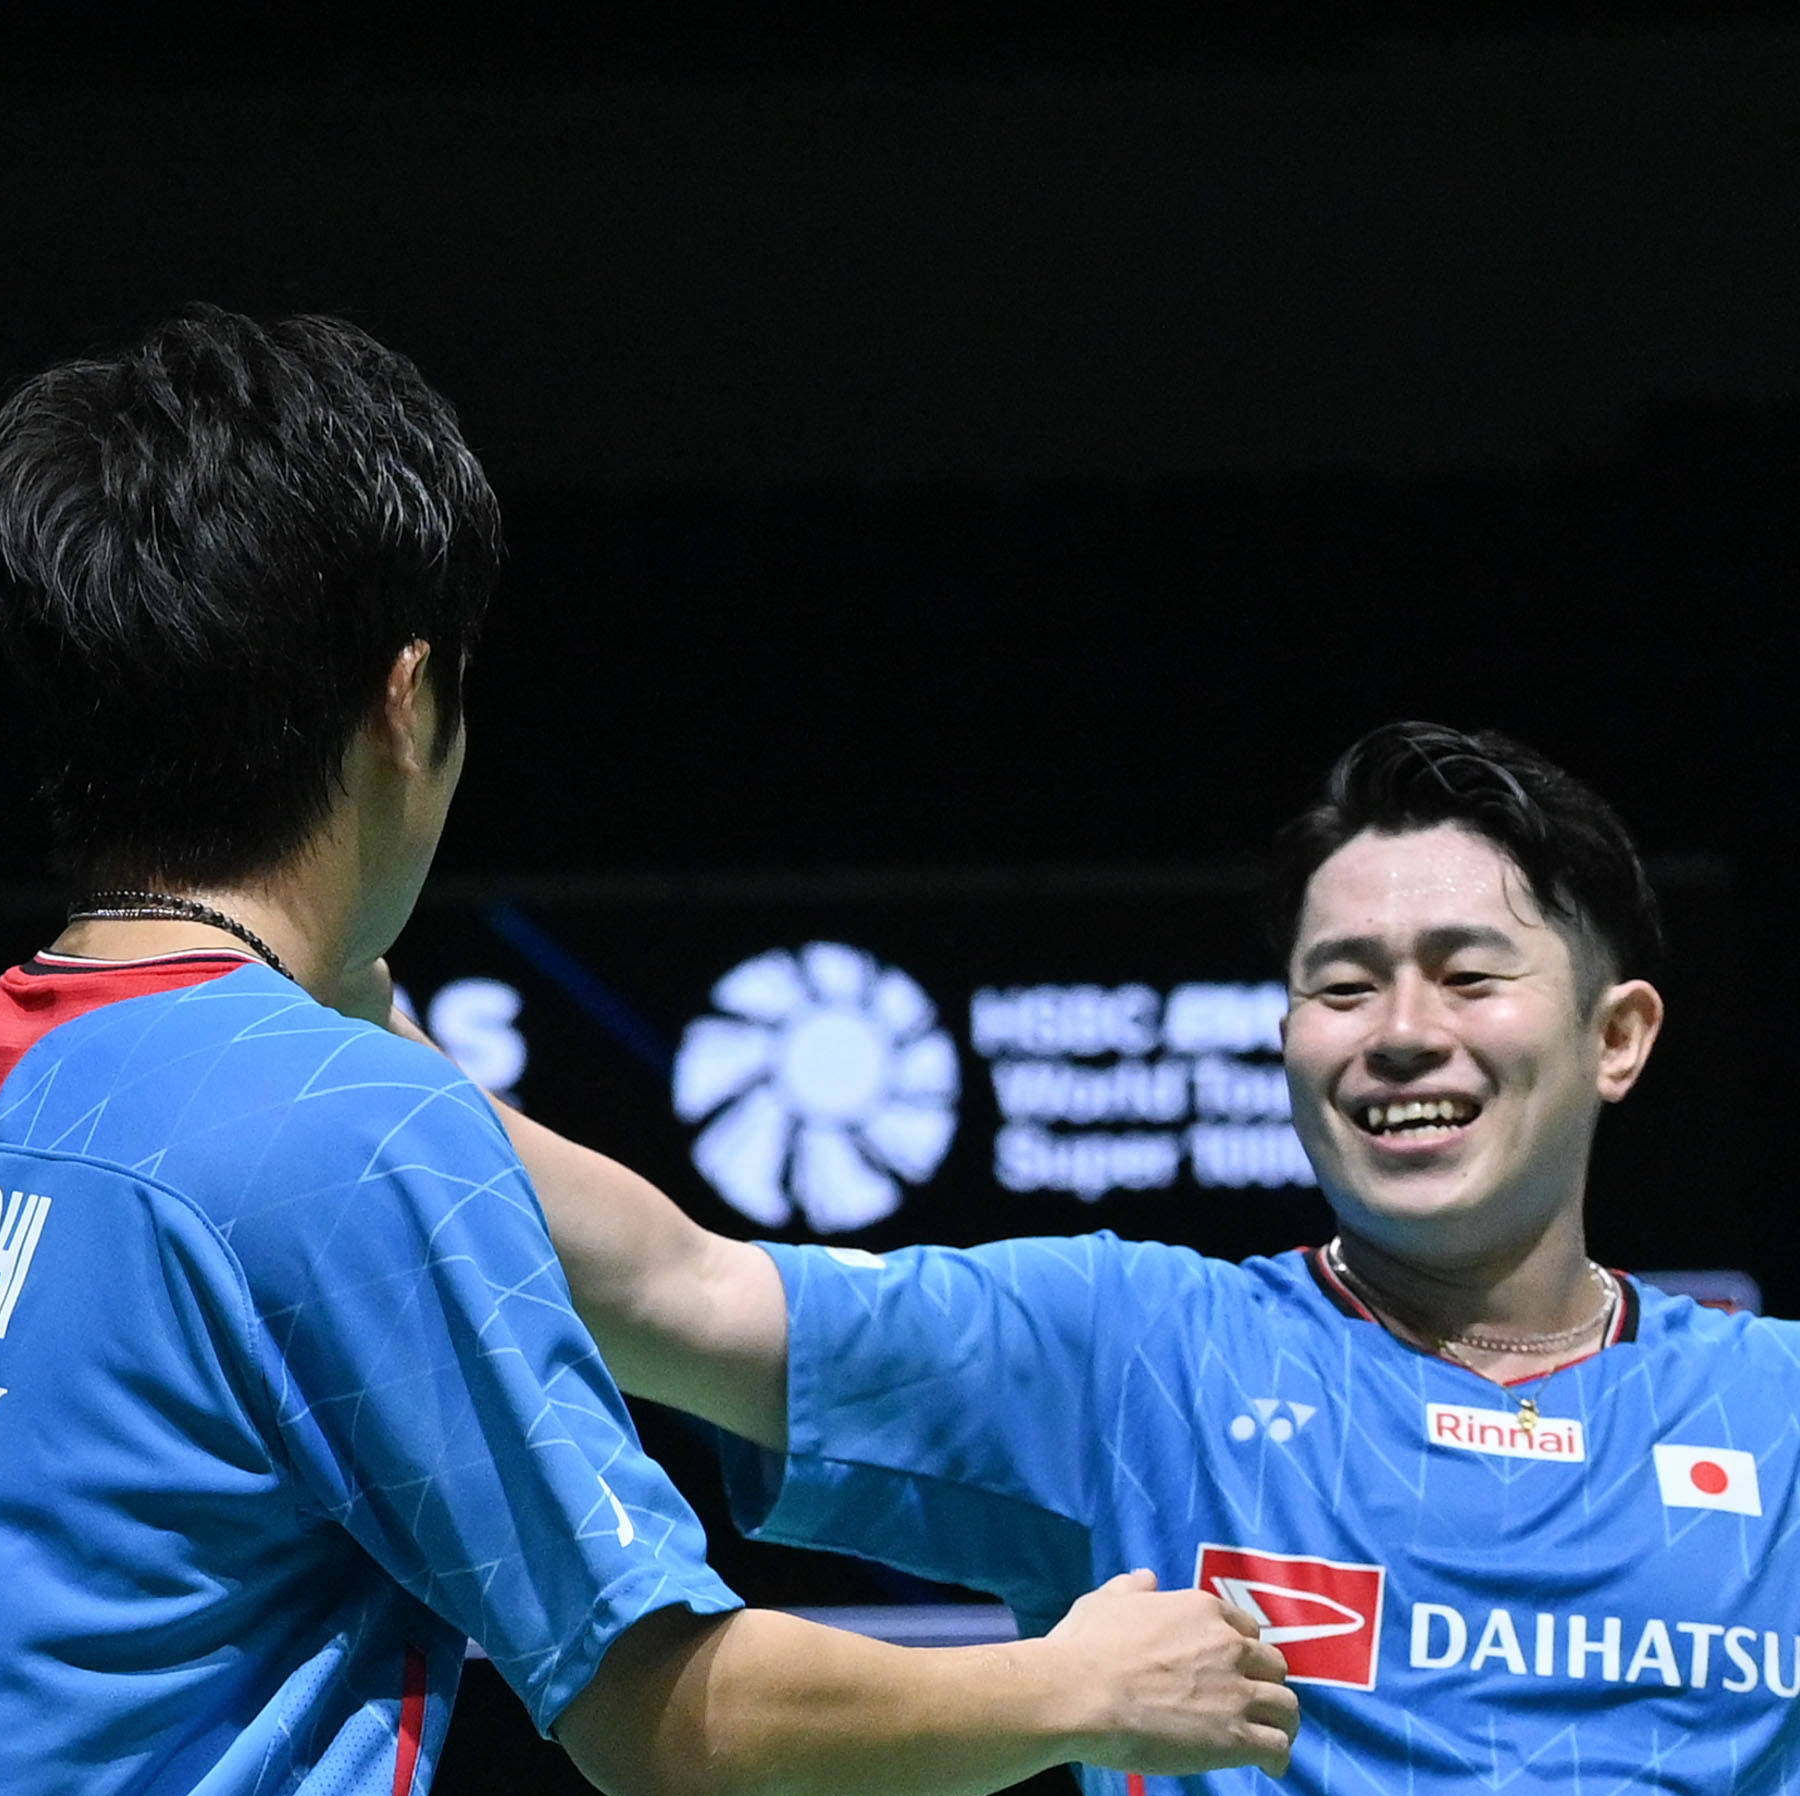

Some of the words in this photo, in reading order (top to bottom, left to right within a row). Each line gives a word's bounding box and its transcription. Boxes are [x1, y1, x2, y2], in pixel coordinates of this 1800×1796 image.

[993, 1058, 1190, 1124] World
[1194, 1056, 1292, 1122] Tou
[994, 1124, 1180, 1200] Super
[1435, 1412, 1576, 1455] Rinnai
